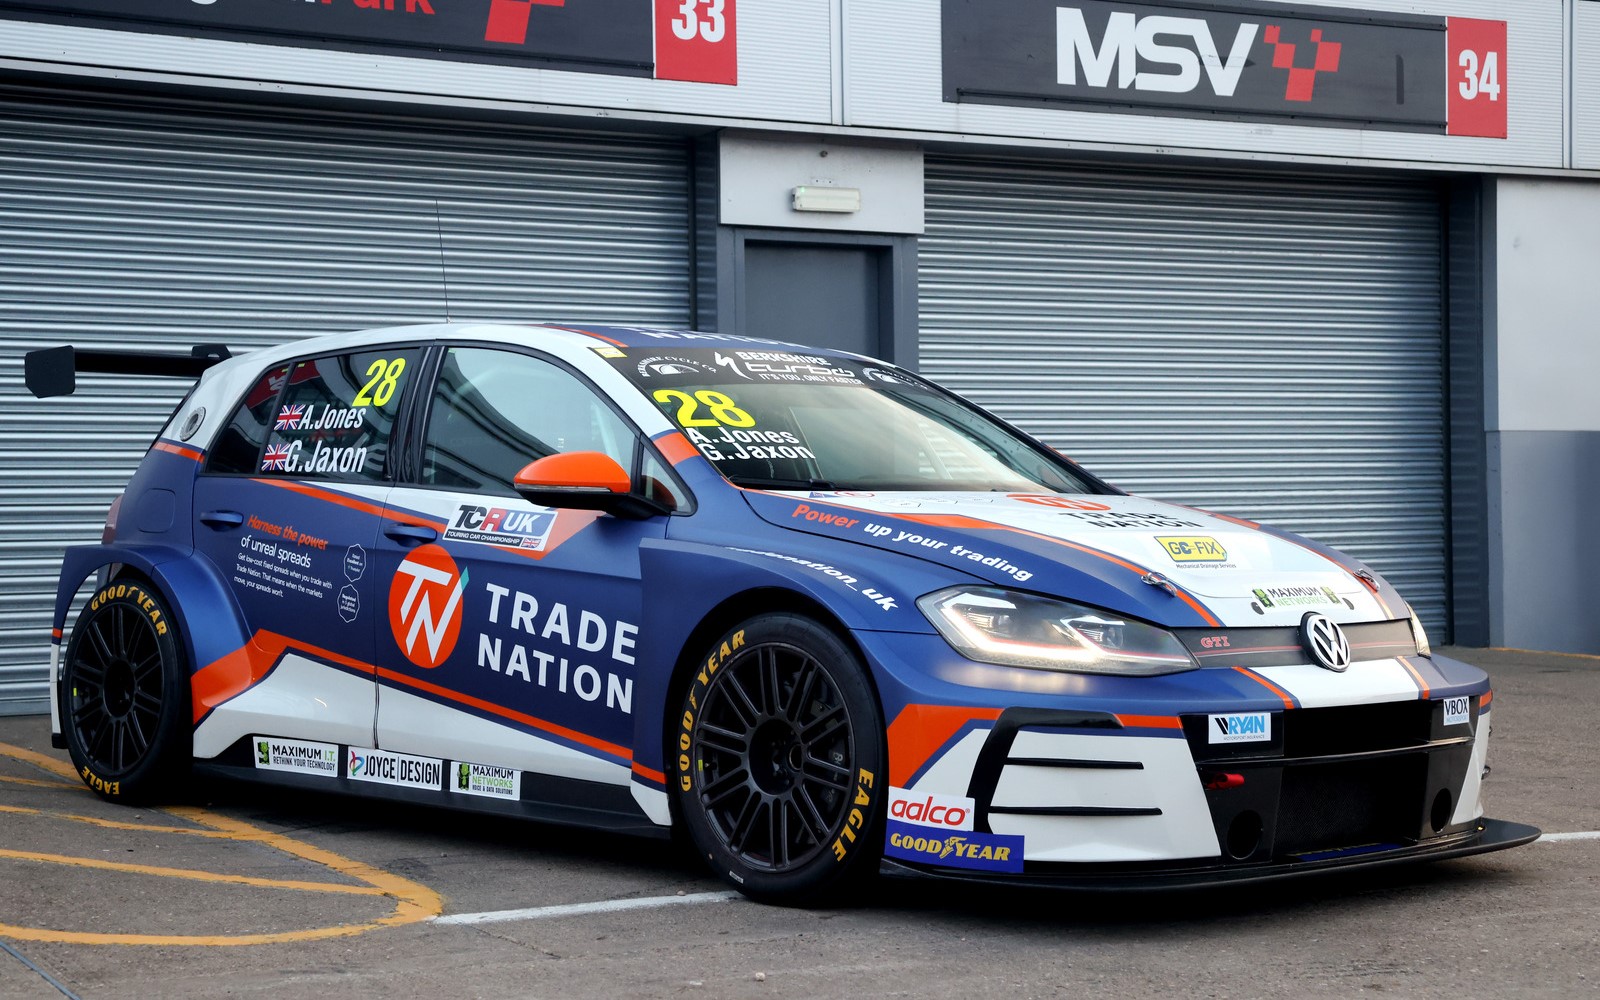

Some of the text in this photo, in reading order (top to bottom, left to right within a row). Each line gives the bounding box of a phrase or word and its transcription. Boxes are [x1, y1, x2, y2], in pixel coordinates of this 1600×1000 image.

[671, 0, 726, 43] 33
[1056, 6, 1260, 97] MSV
[1459, 49, 1500, 101] 34
[735, 351, 832, 366] BERKSHIRE
[744, 362, 855, 377] turbo
[352, 357, 406, 407] 28
[803, 374, 828, 382] ONLY
[828, 376, 865, 385] FASTER
[298, 403, 367, 430] A.Jones
[652, 389, 756, 428] 28
[685, 426, 800, 445] A.Jones
[284, 440, 367, 473] G.Jaxon
[698, 442, 816, 461] G.Jaxon
[454, 504, 541, 533] TCR UK
[1058, 512, 1179, 520] TRADE
[1086, 520, 1205, 528] NATION
[246, 514, 329, 551] Harness the power
[447, 530, 520, 545] TOURING CAR CHAMPIONSHIP
[791, 503, 1034, 582] Power up your trading
[240, 534, 312, 568] of unreal spreads
[237, 552, 246, 561] Get
[289, 570, 302, 579] when
[301, 574, 310, 582] you
[322, 580, 333, 589] with
[262, 571, 272, 581] That
[285, 580, 298, 590] when
[297, 584, 306, 593] the
[1267, 586, 1322, 599] MAXIMUM
[1275, 596, 1328, 607] NETWORKS
[485, 582, 639, 666] TRADE
[1200, 635, 1231, 649] GTI
[477, 632, 633, 714] NATION
[1444, 698, 1468, 715] VBOX
[1228, 715, 1265, 735] RYAN
[272, 744, 336, 762] MAXIMUM I.T.
[273, 756, 336, 771] RETHINK YOUR TECHNOLOGY
[82, 765, 120, 795] EAGLE
[363, 755, 440, 786] JOYCE DESIGN
[472, 765, 514, 780] MAXIMUM
[471, 776, 514, 789] NETWORKS
[495, 787, 513, 796] SOLUTIONS
[831, 767, 874, 862] EAGLE
[891, 796, 966, 826] aalco
